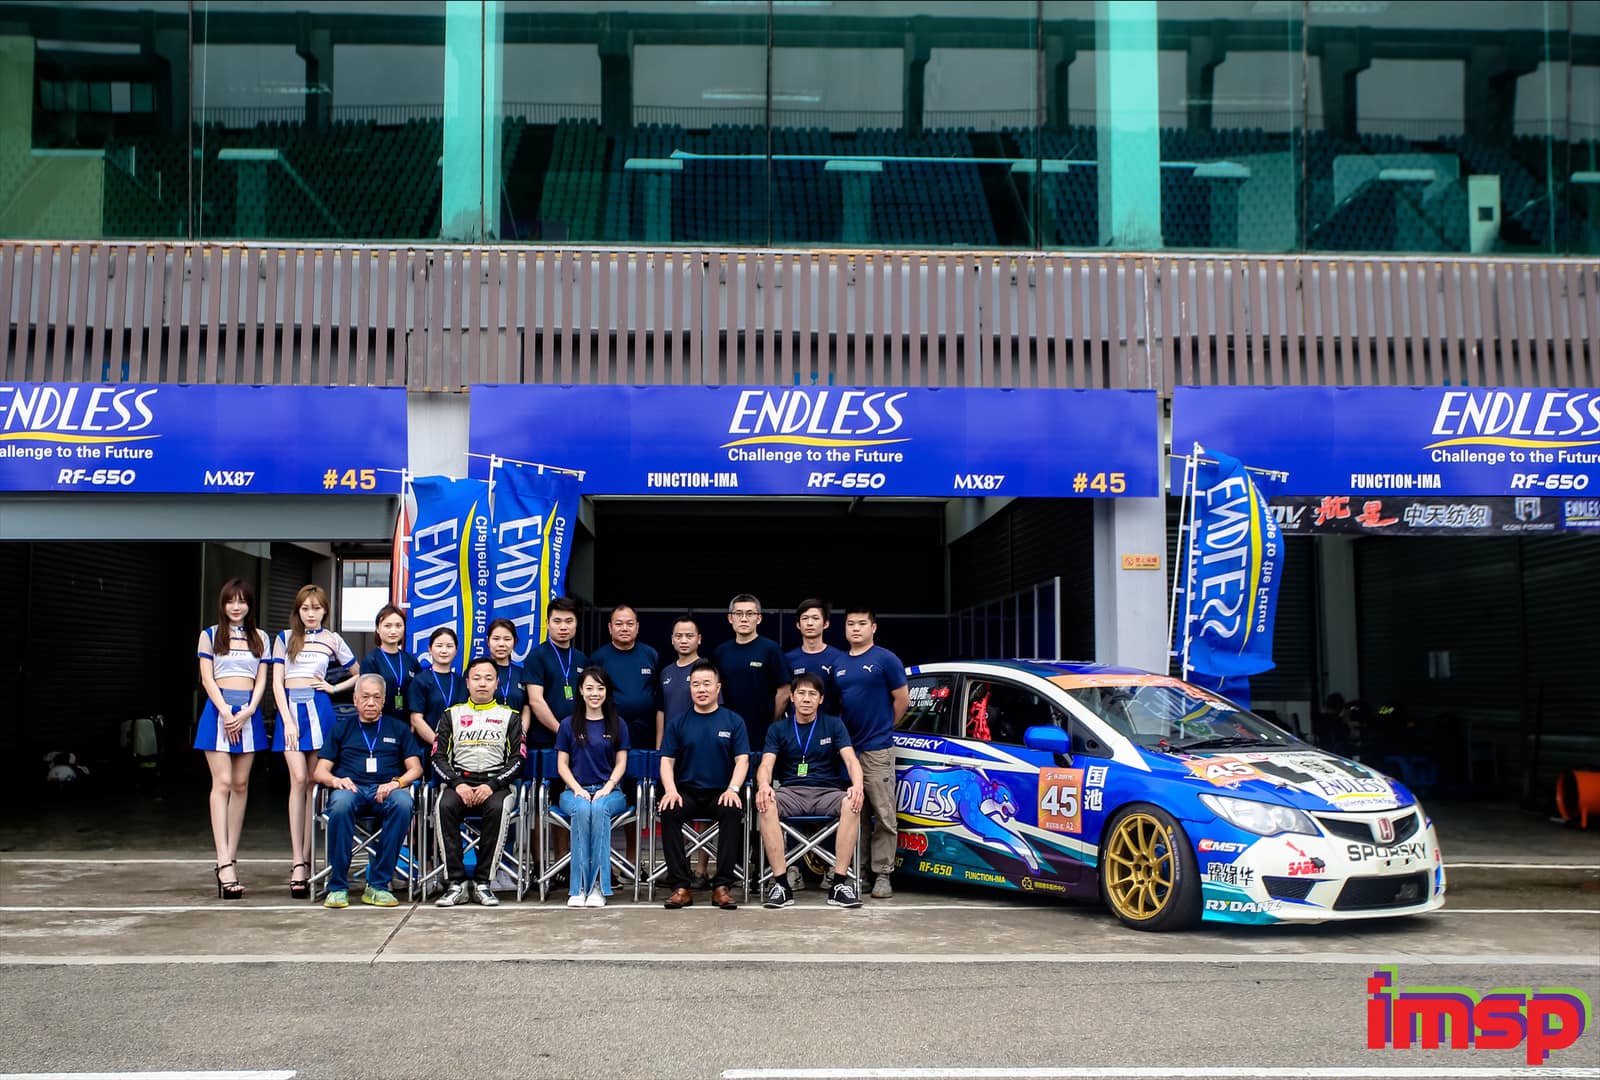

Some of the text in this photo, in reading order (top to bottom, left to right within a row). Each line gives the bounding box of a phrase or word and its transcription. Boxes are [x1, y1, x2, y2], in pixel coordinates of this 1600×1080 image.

[728, 390, 909, 434] ENDLESS
[1431, 391, 1600, 436] ENDLESS
[0, 444, 154, 461] allenge to the Future
[728, 448, 904, 464] Challenge to the Future
[1431, 449, 1600, 465] Challenge to the Futur
[57, 469, 376, 490] RF-650 MX87 #45
[647, 473, 1126, 494] FUNCTION-IMA RF-650 MX87 #45
[1350, 473, 1589, 490] FUNCTION-IMA RF-650
[1403, 503, 1492, 528] 中天纺织
[1564, 500, 1600, 518] ENDLES
[459, 729, 502, 741] ENDLESS
[892, 735, 944, 749] ORSKY
[1206, 761, 1255, 779] 45
[1315, 778, 1387, 796] ENDLESS
[895, 779, 960, 817] DLESS
[1041, 785, 1078, 818] 45
[897, 831, 928, 856] msp
[919, 861, 953, 876] RF-650
[1205, 899, 1283, 913] RYDANZ
